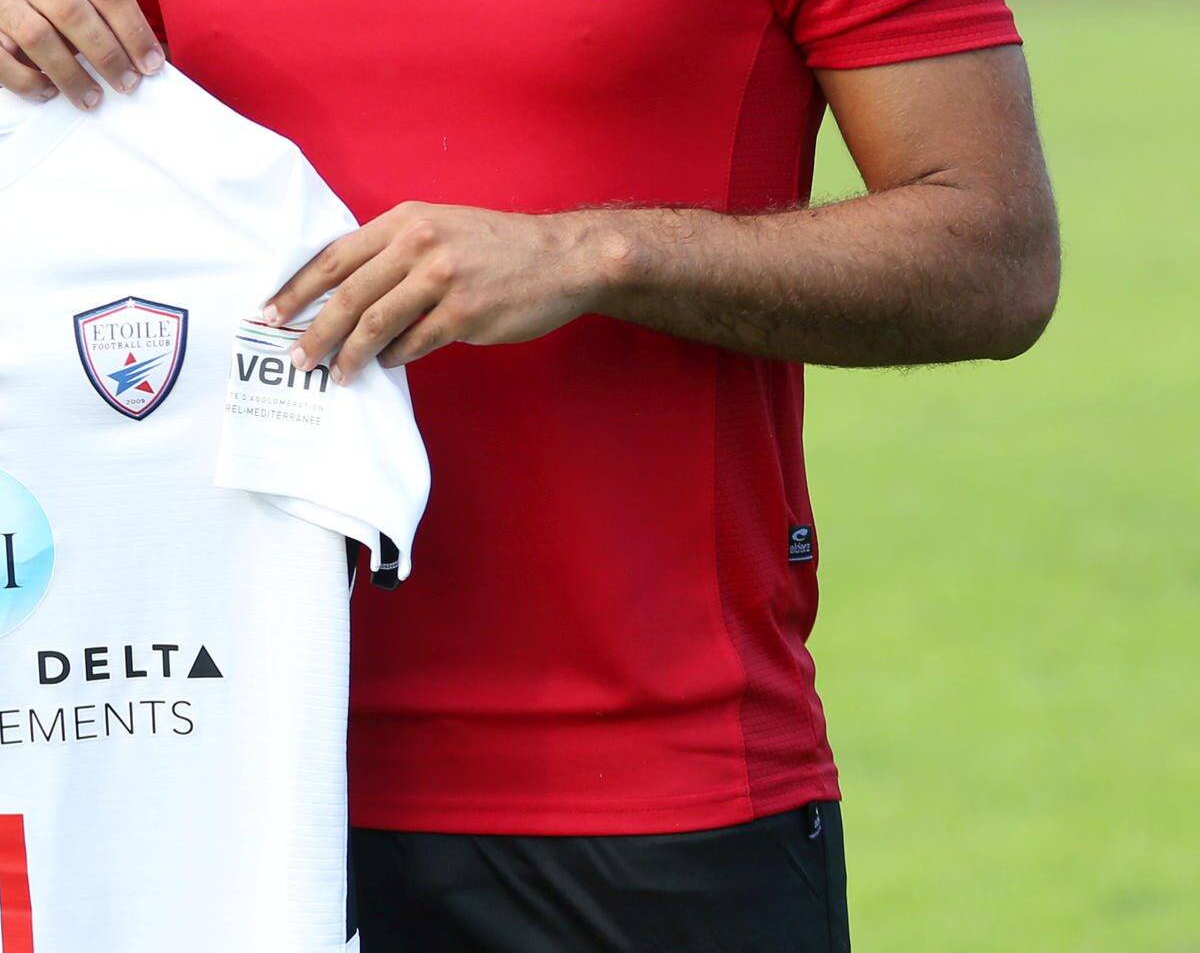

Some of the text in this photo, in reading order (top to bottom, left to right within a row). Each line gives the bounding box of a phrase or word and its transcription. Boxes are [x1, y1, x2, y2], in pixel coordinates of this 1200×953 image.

[92, 320, 172, 341] ETOILE
[92, 339, 172, 351] FOOTBALL CLUB
